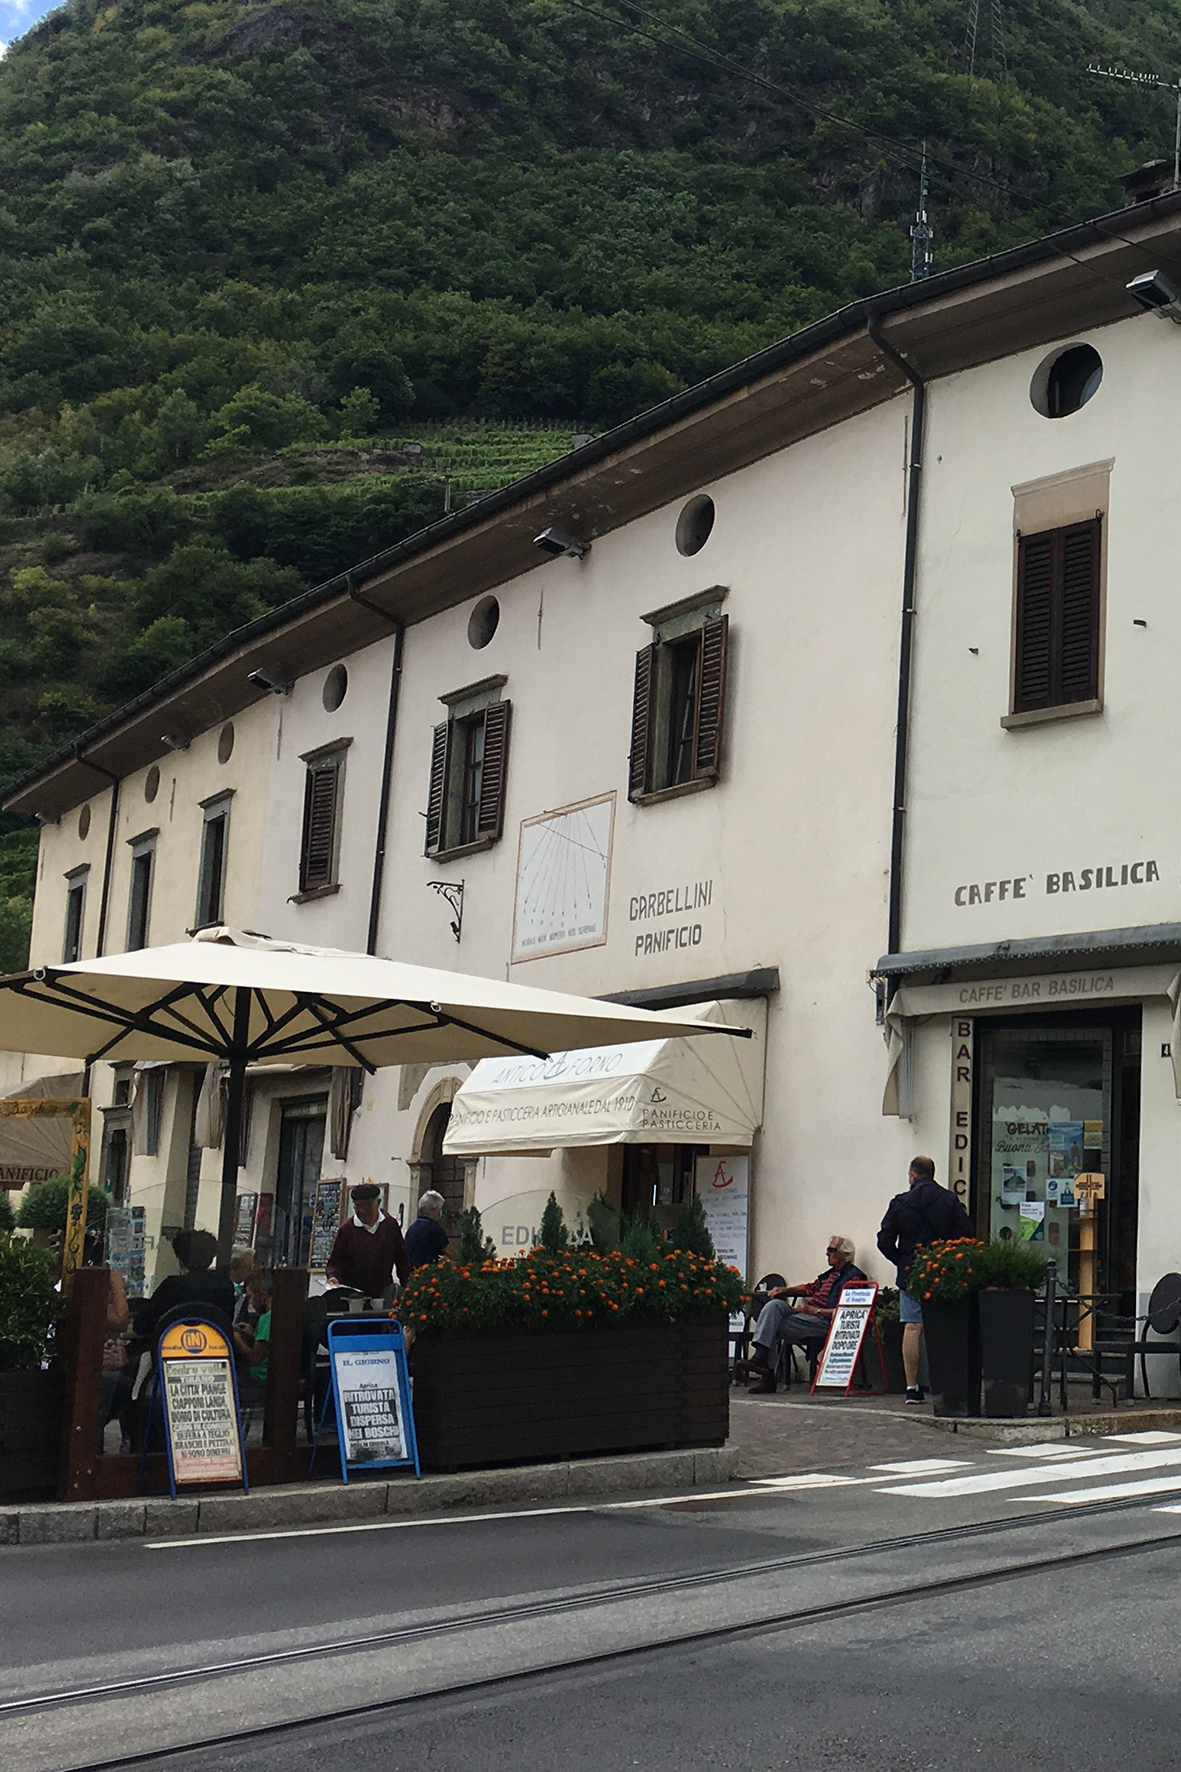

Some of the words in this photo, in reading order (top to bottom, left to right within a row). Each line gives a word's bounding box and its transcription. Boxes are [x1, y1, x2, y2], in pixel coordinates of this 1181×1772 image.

[1046, 860, 1160, 894] BASILICA
[629, 879, 713, 921] GARBELLINI
[635, 923, 702, 957] PANIFICIO
[959, 985, 1007, 1003] CAFFE'
[1012, 982, 1040, 999] BAR
[1049, 976, 1115, 996] BASILICA
[956, 1021, 971, 1083] BAR
[492, 1063, 546, 1085] ANTICO
[565, 1053, 623, 1076] FORNO
[492, 1106, 540, 1122] PASTICCERIA
[613, 1096, 635, 1111] 1910
[642, 1109, 706, 1121] PANIFICIO
[707, 1111, 714, 1121] E
[642, 1119, 722, 1131] PASTICCERIA
[1005, 1121, 1048, 1136] GELAT
[953, 1111, 969, 1211] EDIC
[501, 1225, 594, 1246] EDILA
[355, 1358, 390, 1366] GIORNO
[170, 1385, 179, 1396] LA
[344, 1390, 395, 1402] RITROVATA
[201, 1408, 231, 1421] CULTURA
[351, 1402, 390, 1414] TURISTA
[350, 1414, 395, 1427] DISPERSA
[349, 1428, 362, 1439] NEI
[364, 1426, 399, 1438] BOSCHI
